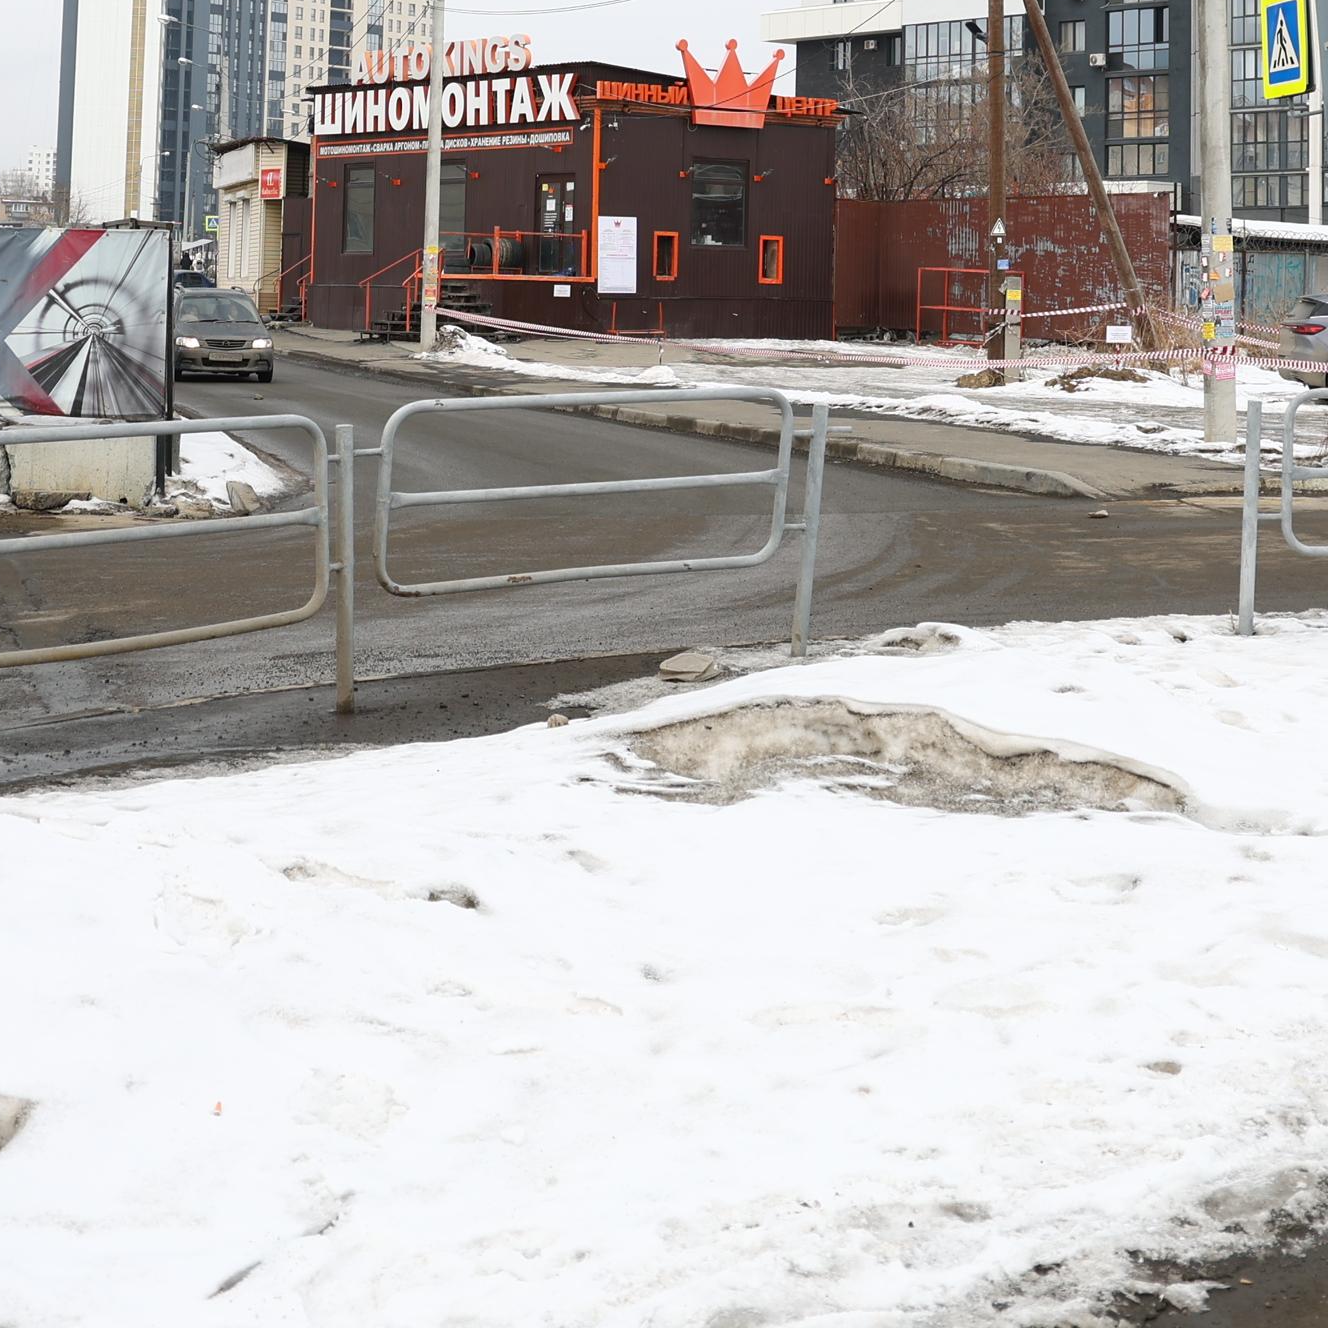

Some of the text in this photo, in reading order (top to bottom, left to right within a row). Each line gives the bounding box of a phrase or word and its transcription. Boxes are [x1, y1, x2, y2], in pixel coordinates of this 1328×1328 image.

[314, 73, 579, 136] ШИНОМОНТАЖ
[596, 80, 689, 105] ШИННЫЙ
[775, 95, 840, 118] ЦЕНТР
[373, 143, 393, 153] СВАРКА
[394, 141, 420, 151] АРГОНОМ
[444, 138, 467, 150] ДИСКОВ
[470, 136, 501, 147] ХРАНЕНИЕ
[502, 135, 528, 145] РЕЗИНЫ
[530, 132, 570, 145] ДОШИПОВКА
